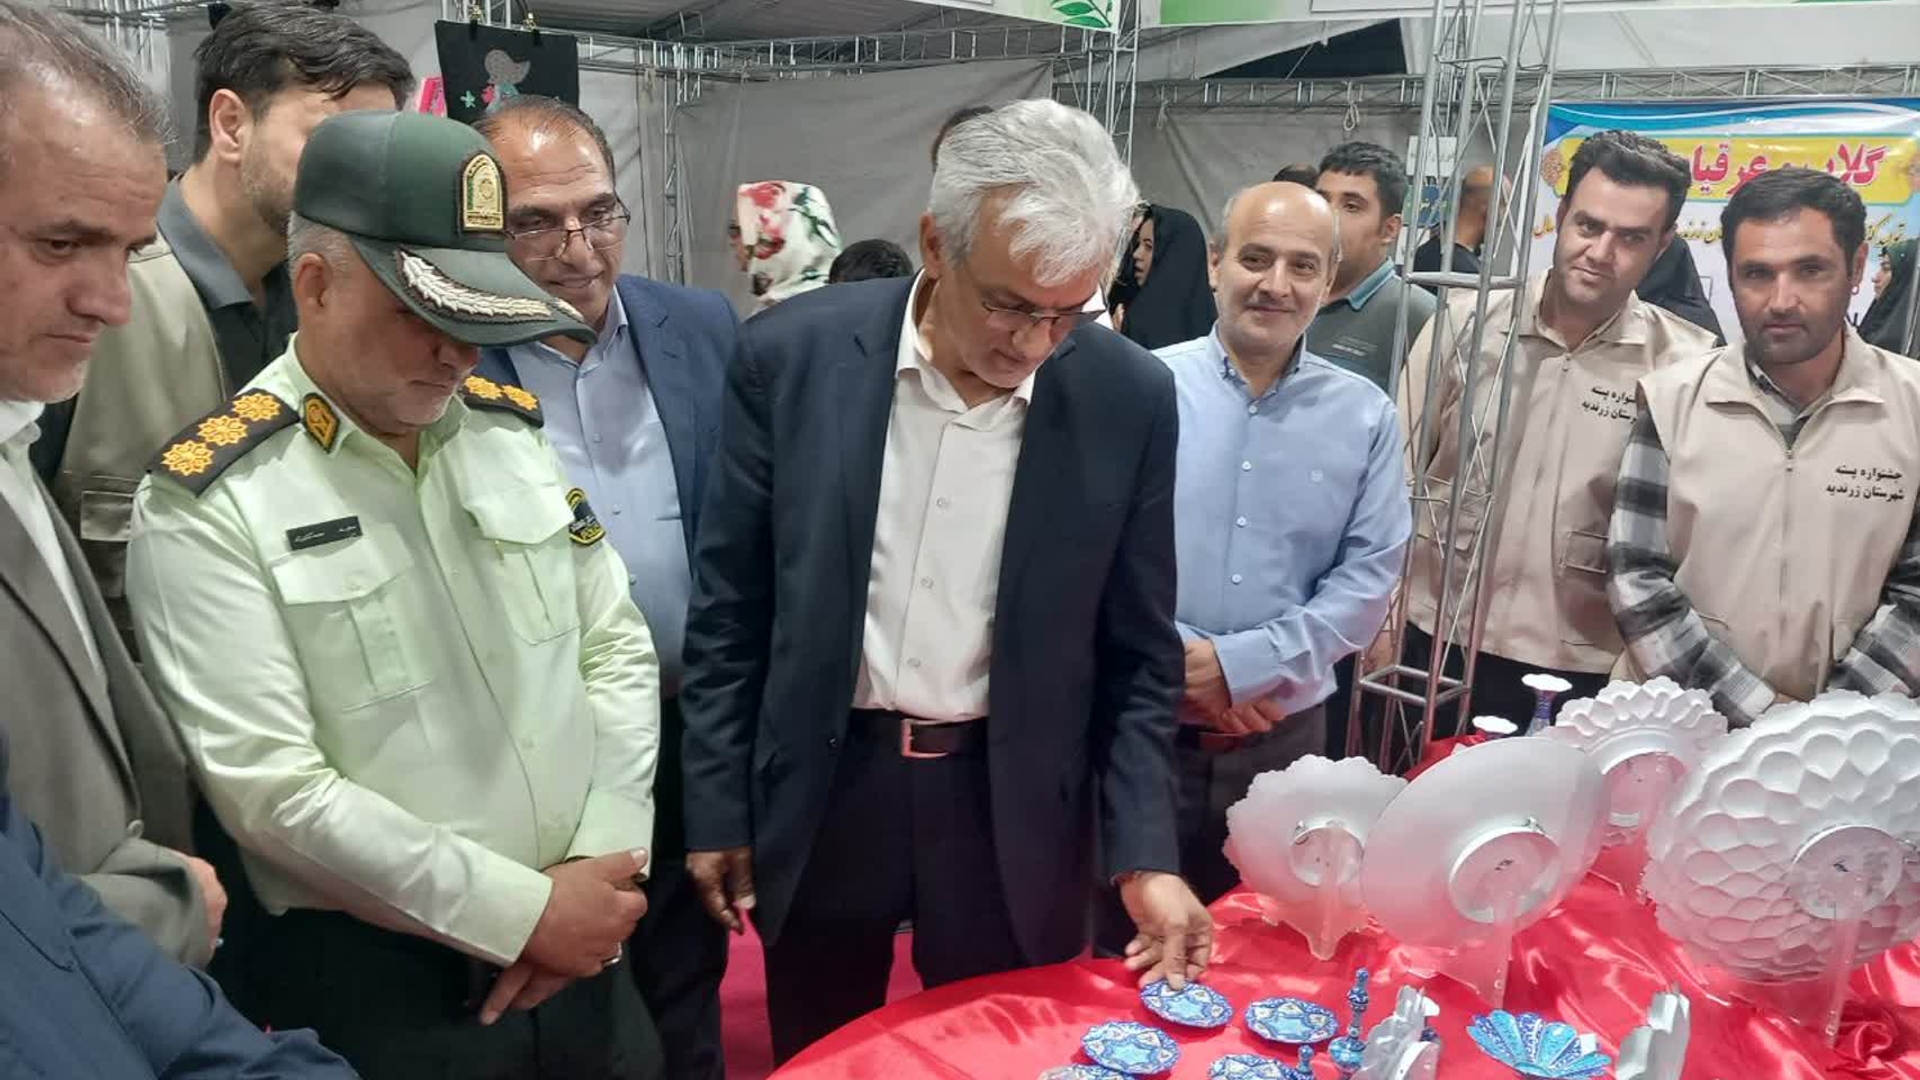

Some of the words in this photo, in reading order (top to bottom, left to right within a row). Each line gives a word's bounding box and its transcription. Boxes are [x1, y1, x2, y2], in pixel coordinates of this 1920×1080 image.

[1692, 143, 1768, 195] عرقیا
[1803, 144, 1888, 184] گلا
[1836, 464, 1857, 479] پسته
[1860, 468, 1902, 483] جشنواره
[1863, 486, 1904, 502] شهرستان
